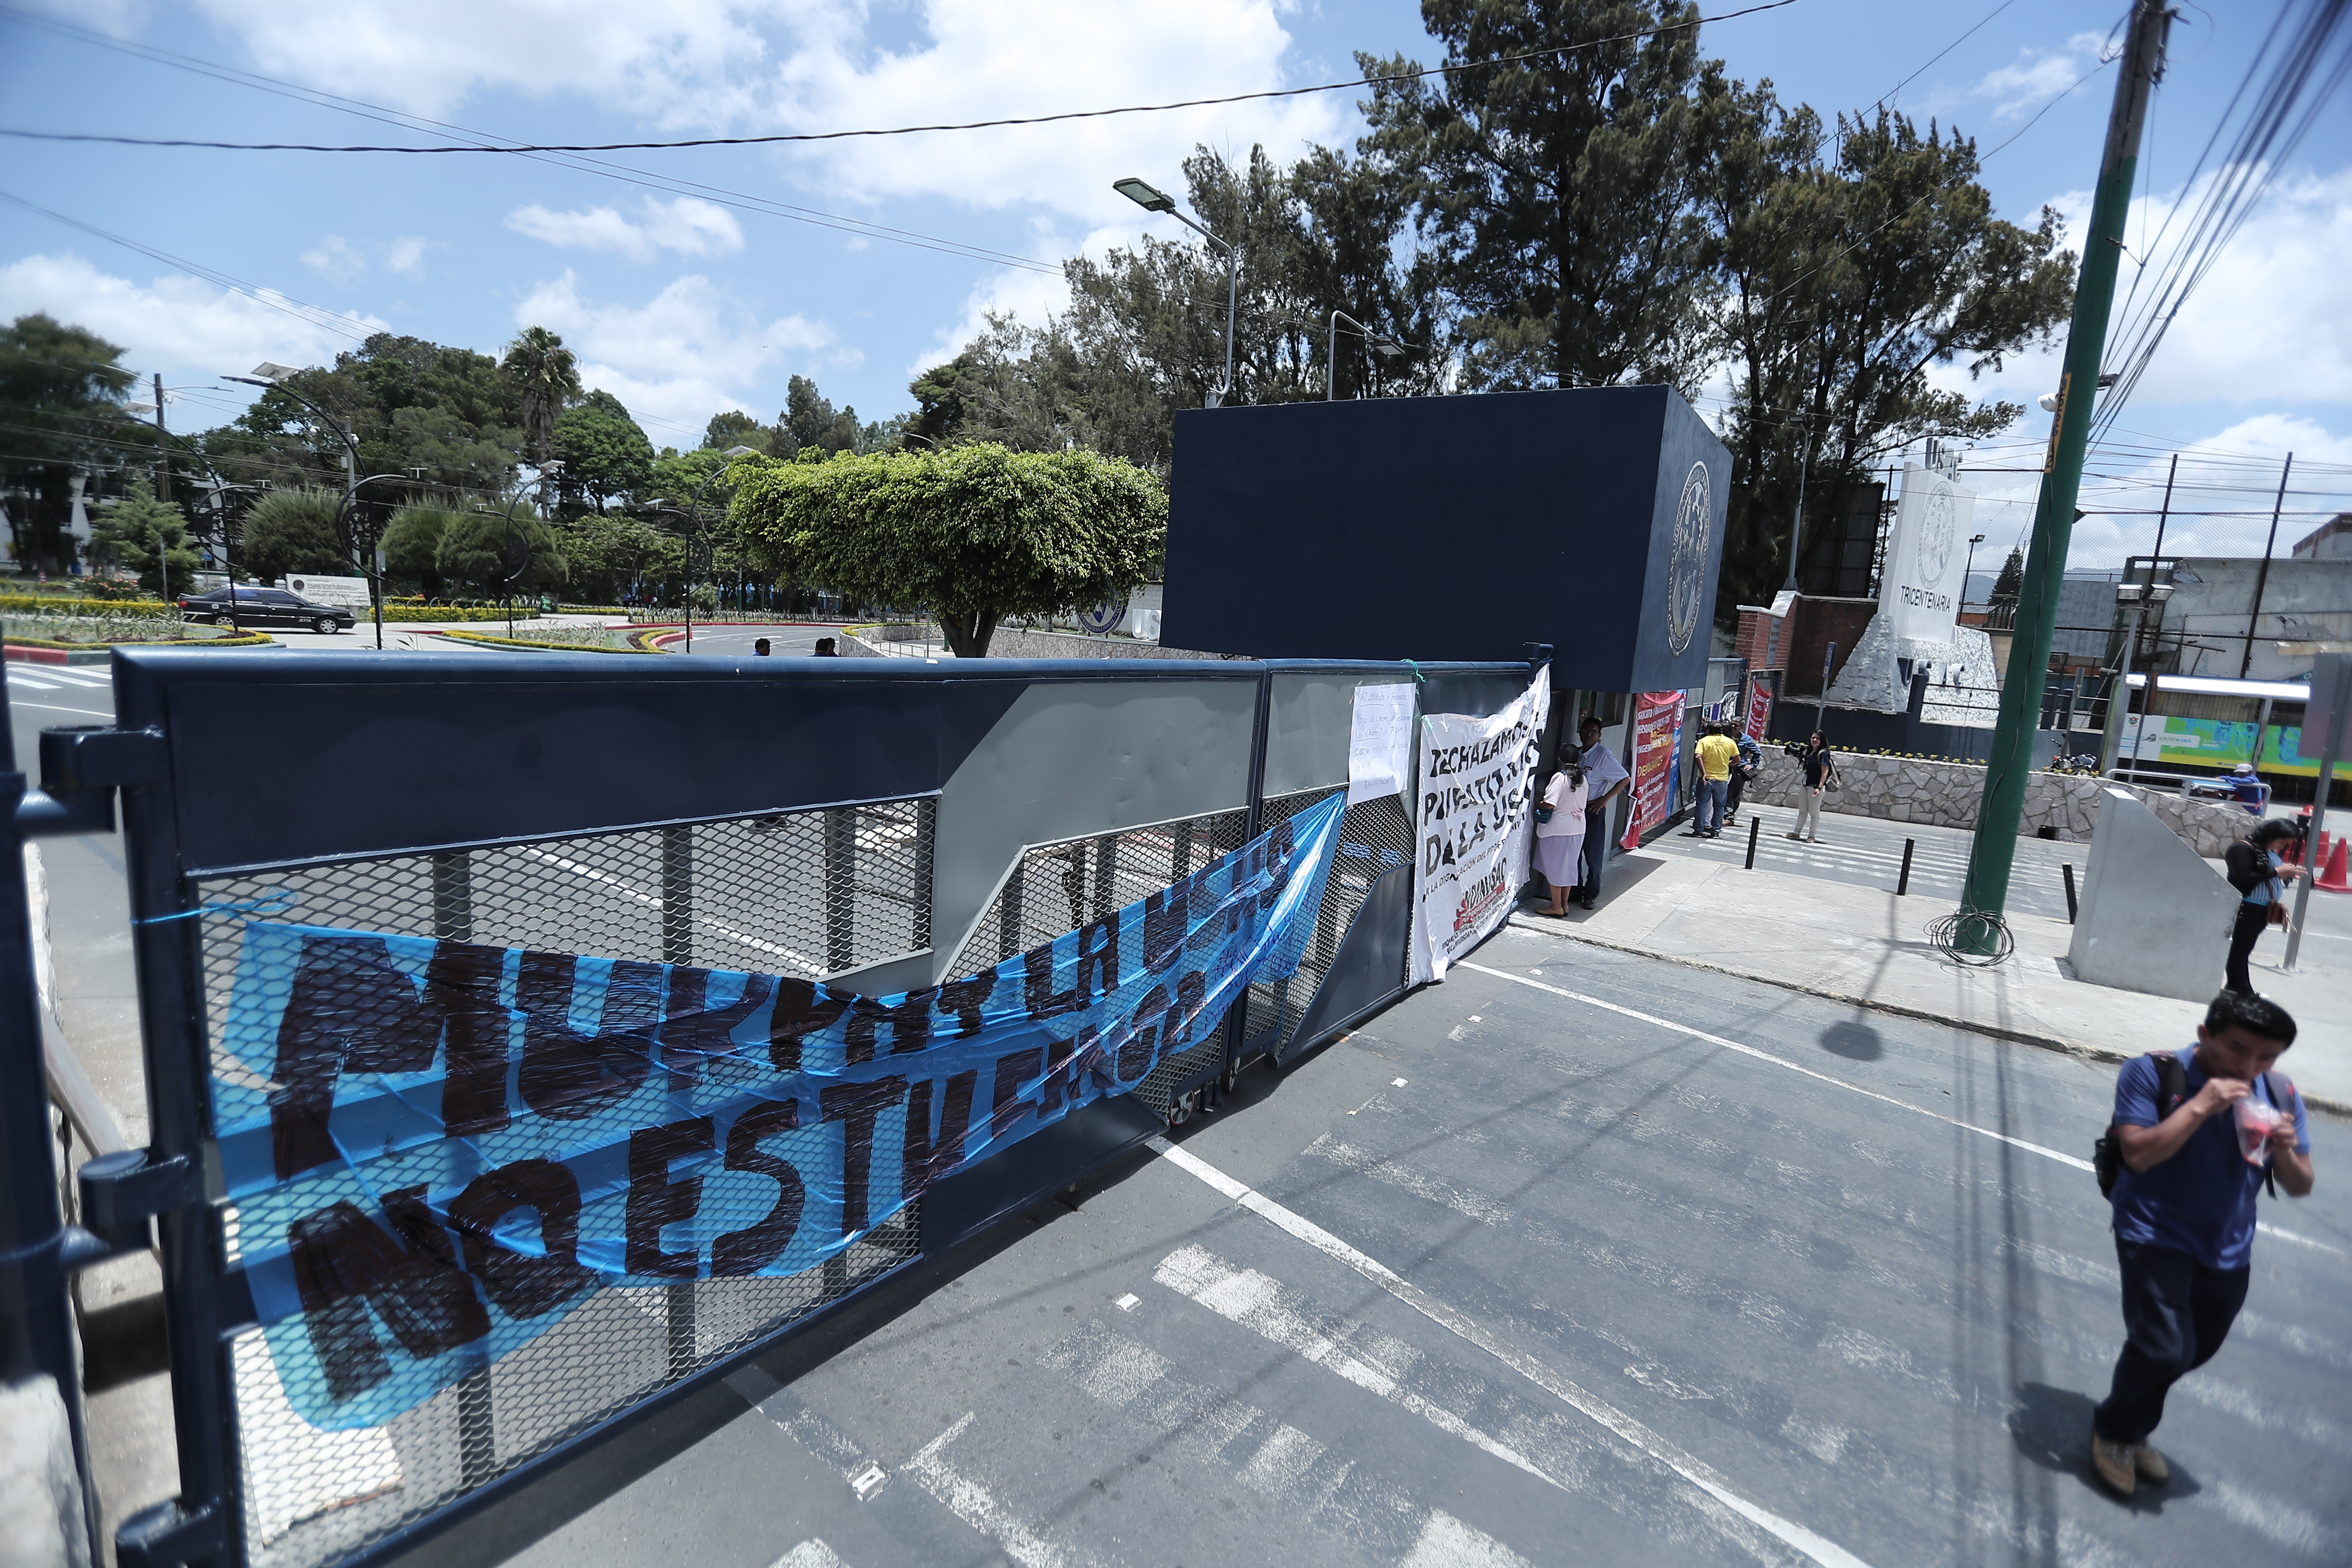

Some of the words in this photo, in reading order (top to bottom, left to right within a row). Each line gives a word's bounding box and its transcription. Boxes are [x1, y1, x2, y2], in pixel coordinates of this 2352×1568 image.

[1925, 438, 1963, 484] USAC
[1900, 585, 1951, 612] TRICENTENARIA
[1458, 811, 1487, 859] LA
[1025, 910, 1120, 1021] LA
[287, 1159, 602, 1404] NO
